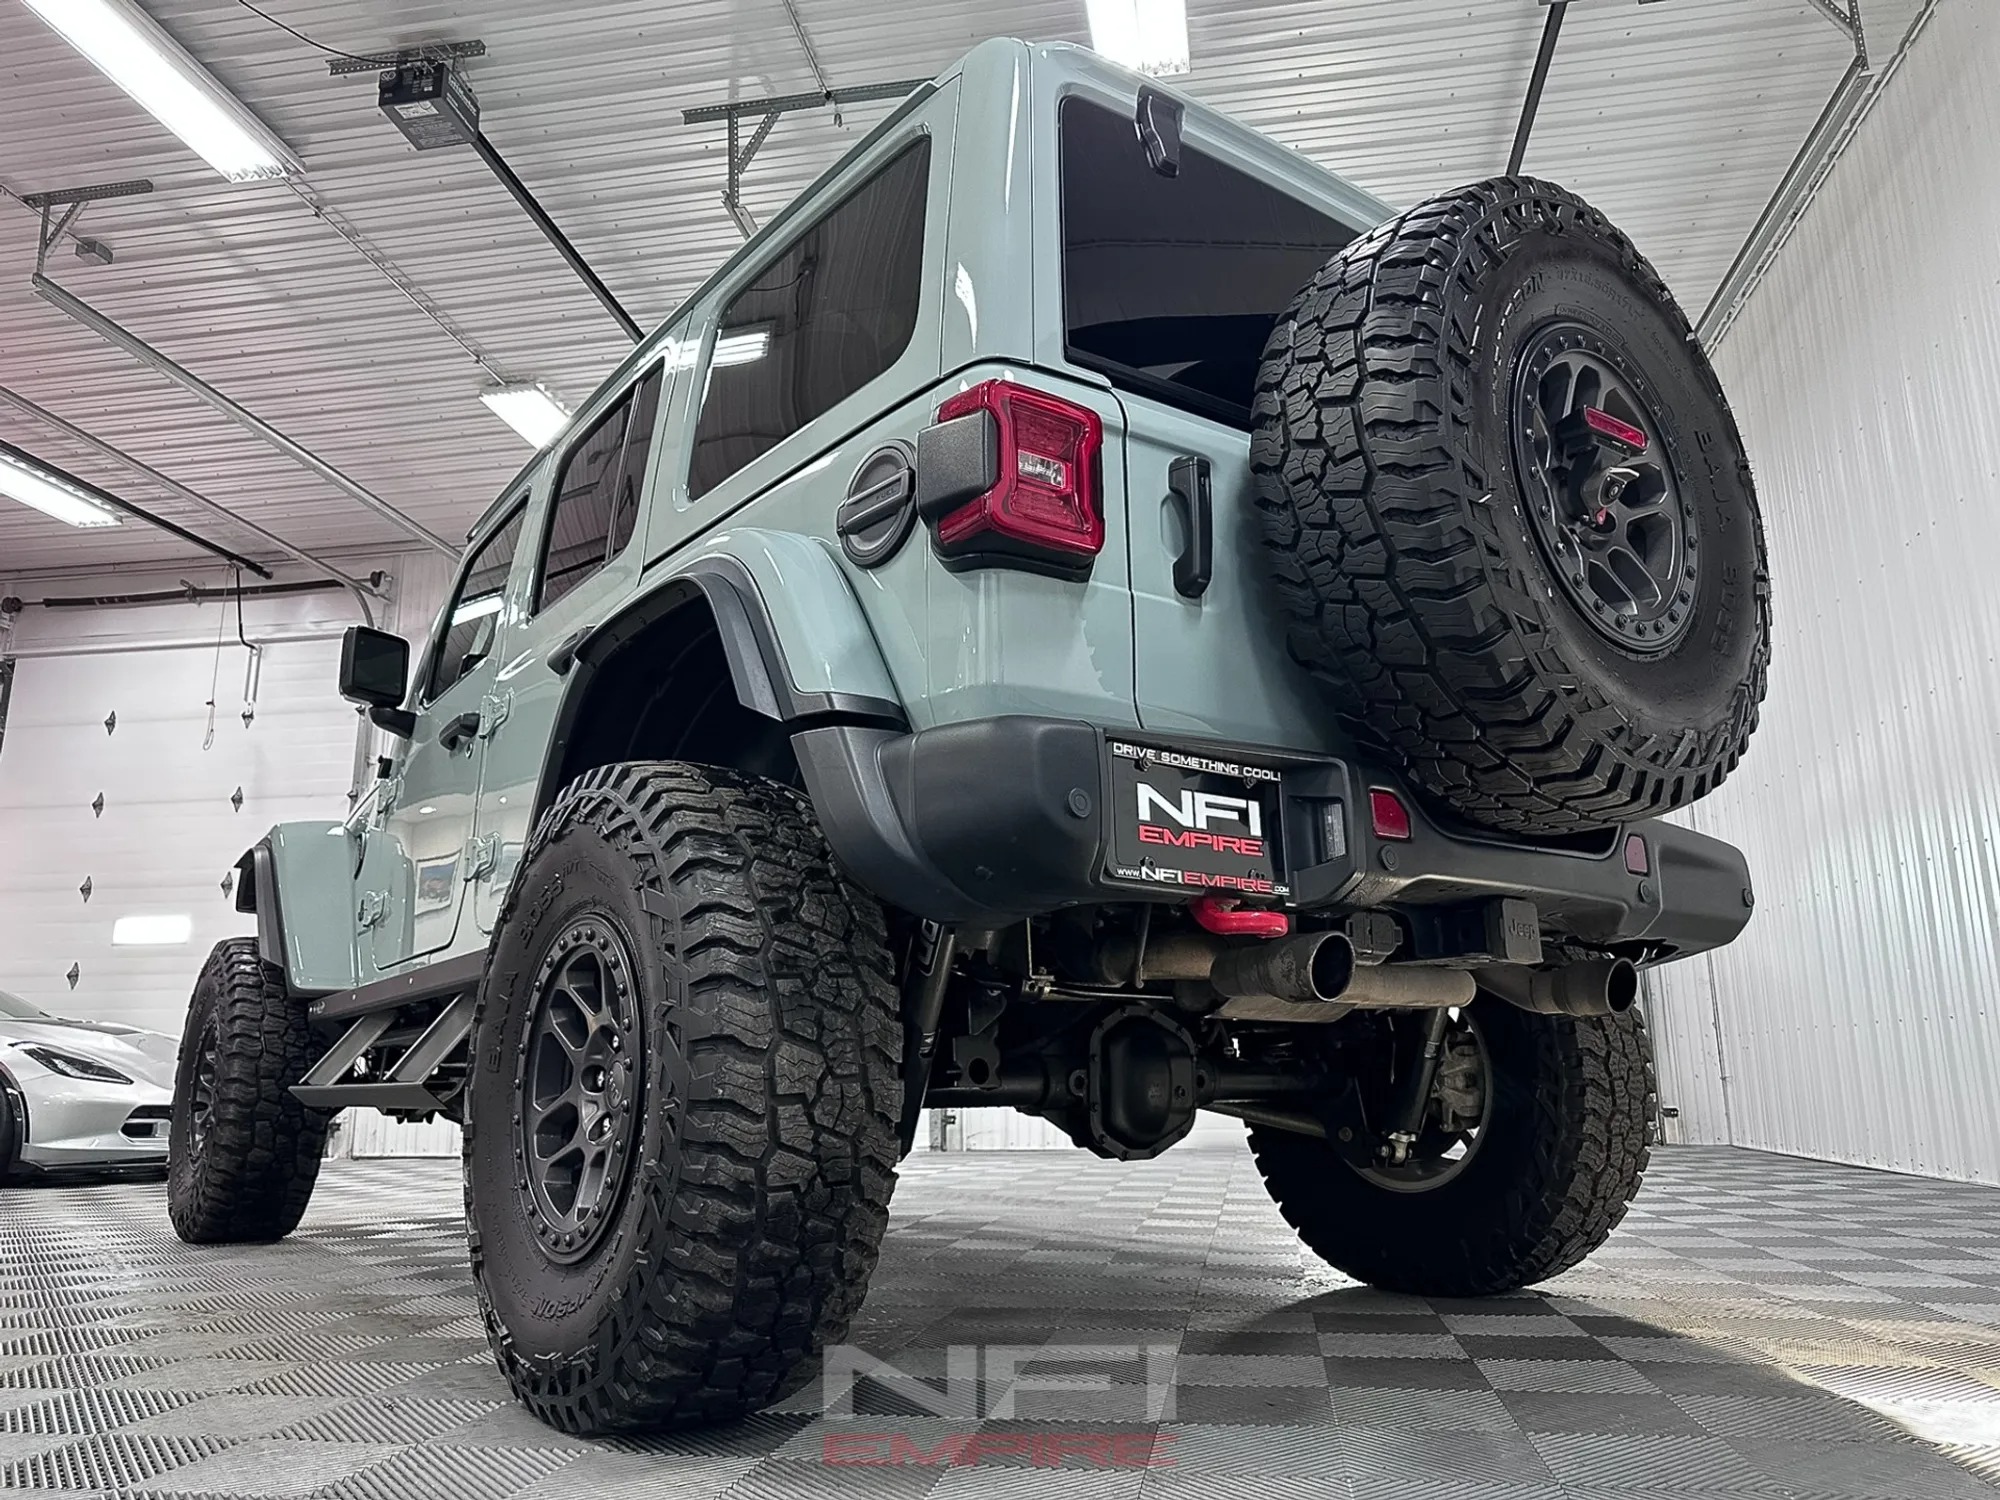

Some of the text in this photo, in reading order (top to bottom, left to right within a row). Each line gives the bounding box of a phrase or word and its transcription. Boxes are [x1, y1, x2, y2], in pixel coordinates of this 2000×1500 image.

[1113, 742, 1282, 782] DRIVE SOMETHING COOL!
[1137, 781, 1262, 838] NFI
[1138, 823, 1264, 858] EMPIRE
[1509, 918, 1536, 940] Jeep
